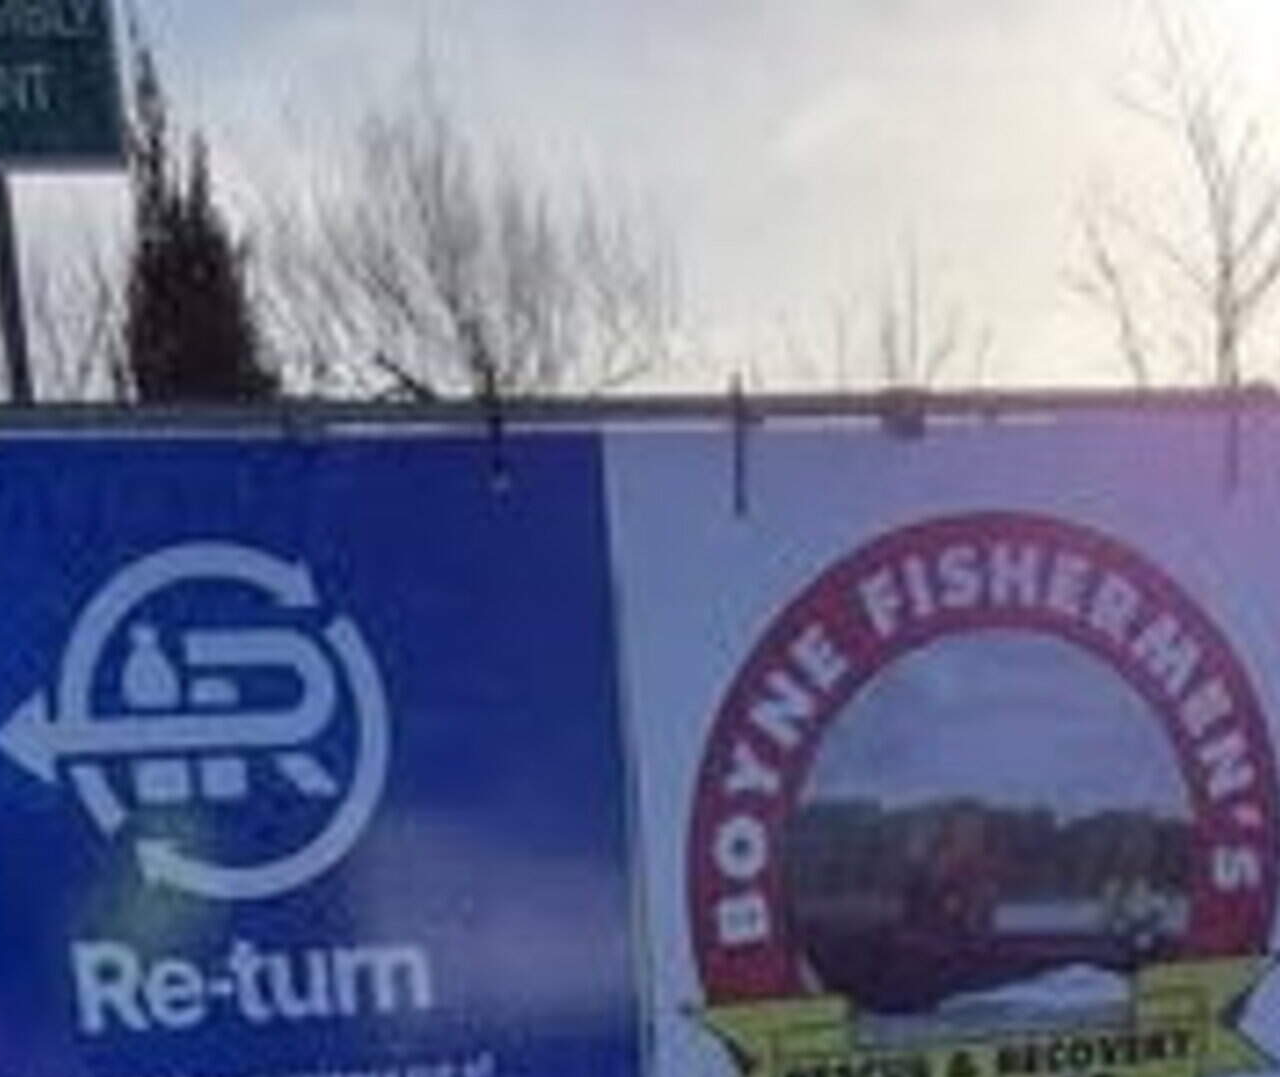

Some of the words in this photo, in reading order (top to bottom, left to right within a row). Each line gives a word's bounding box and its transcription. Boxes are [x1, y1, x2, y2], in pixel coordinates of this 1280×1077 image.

[714, 621, 850, 945] BOYNE
[70, 939, 432, 1035] Re-turn
[995, 1028, 1194, 1075] RECOVERY
